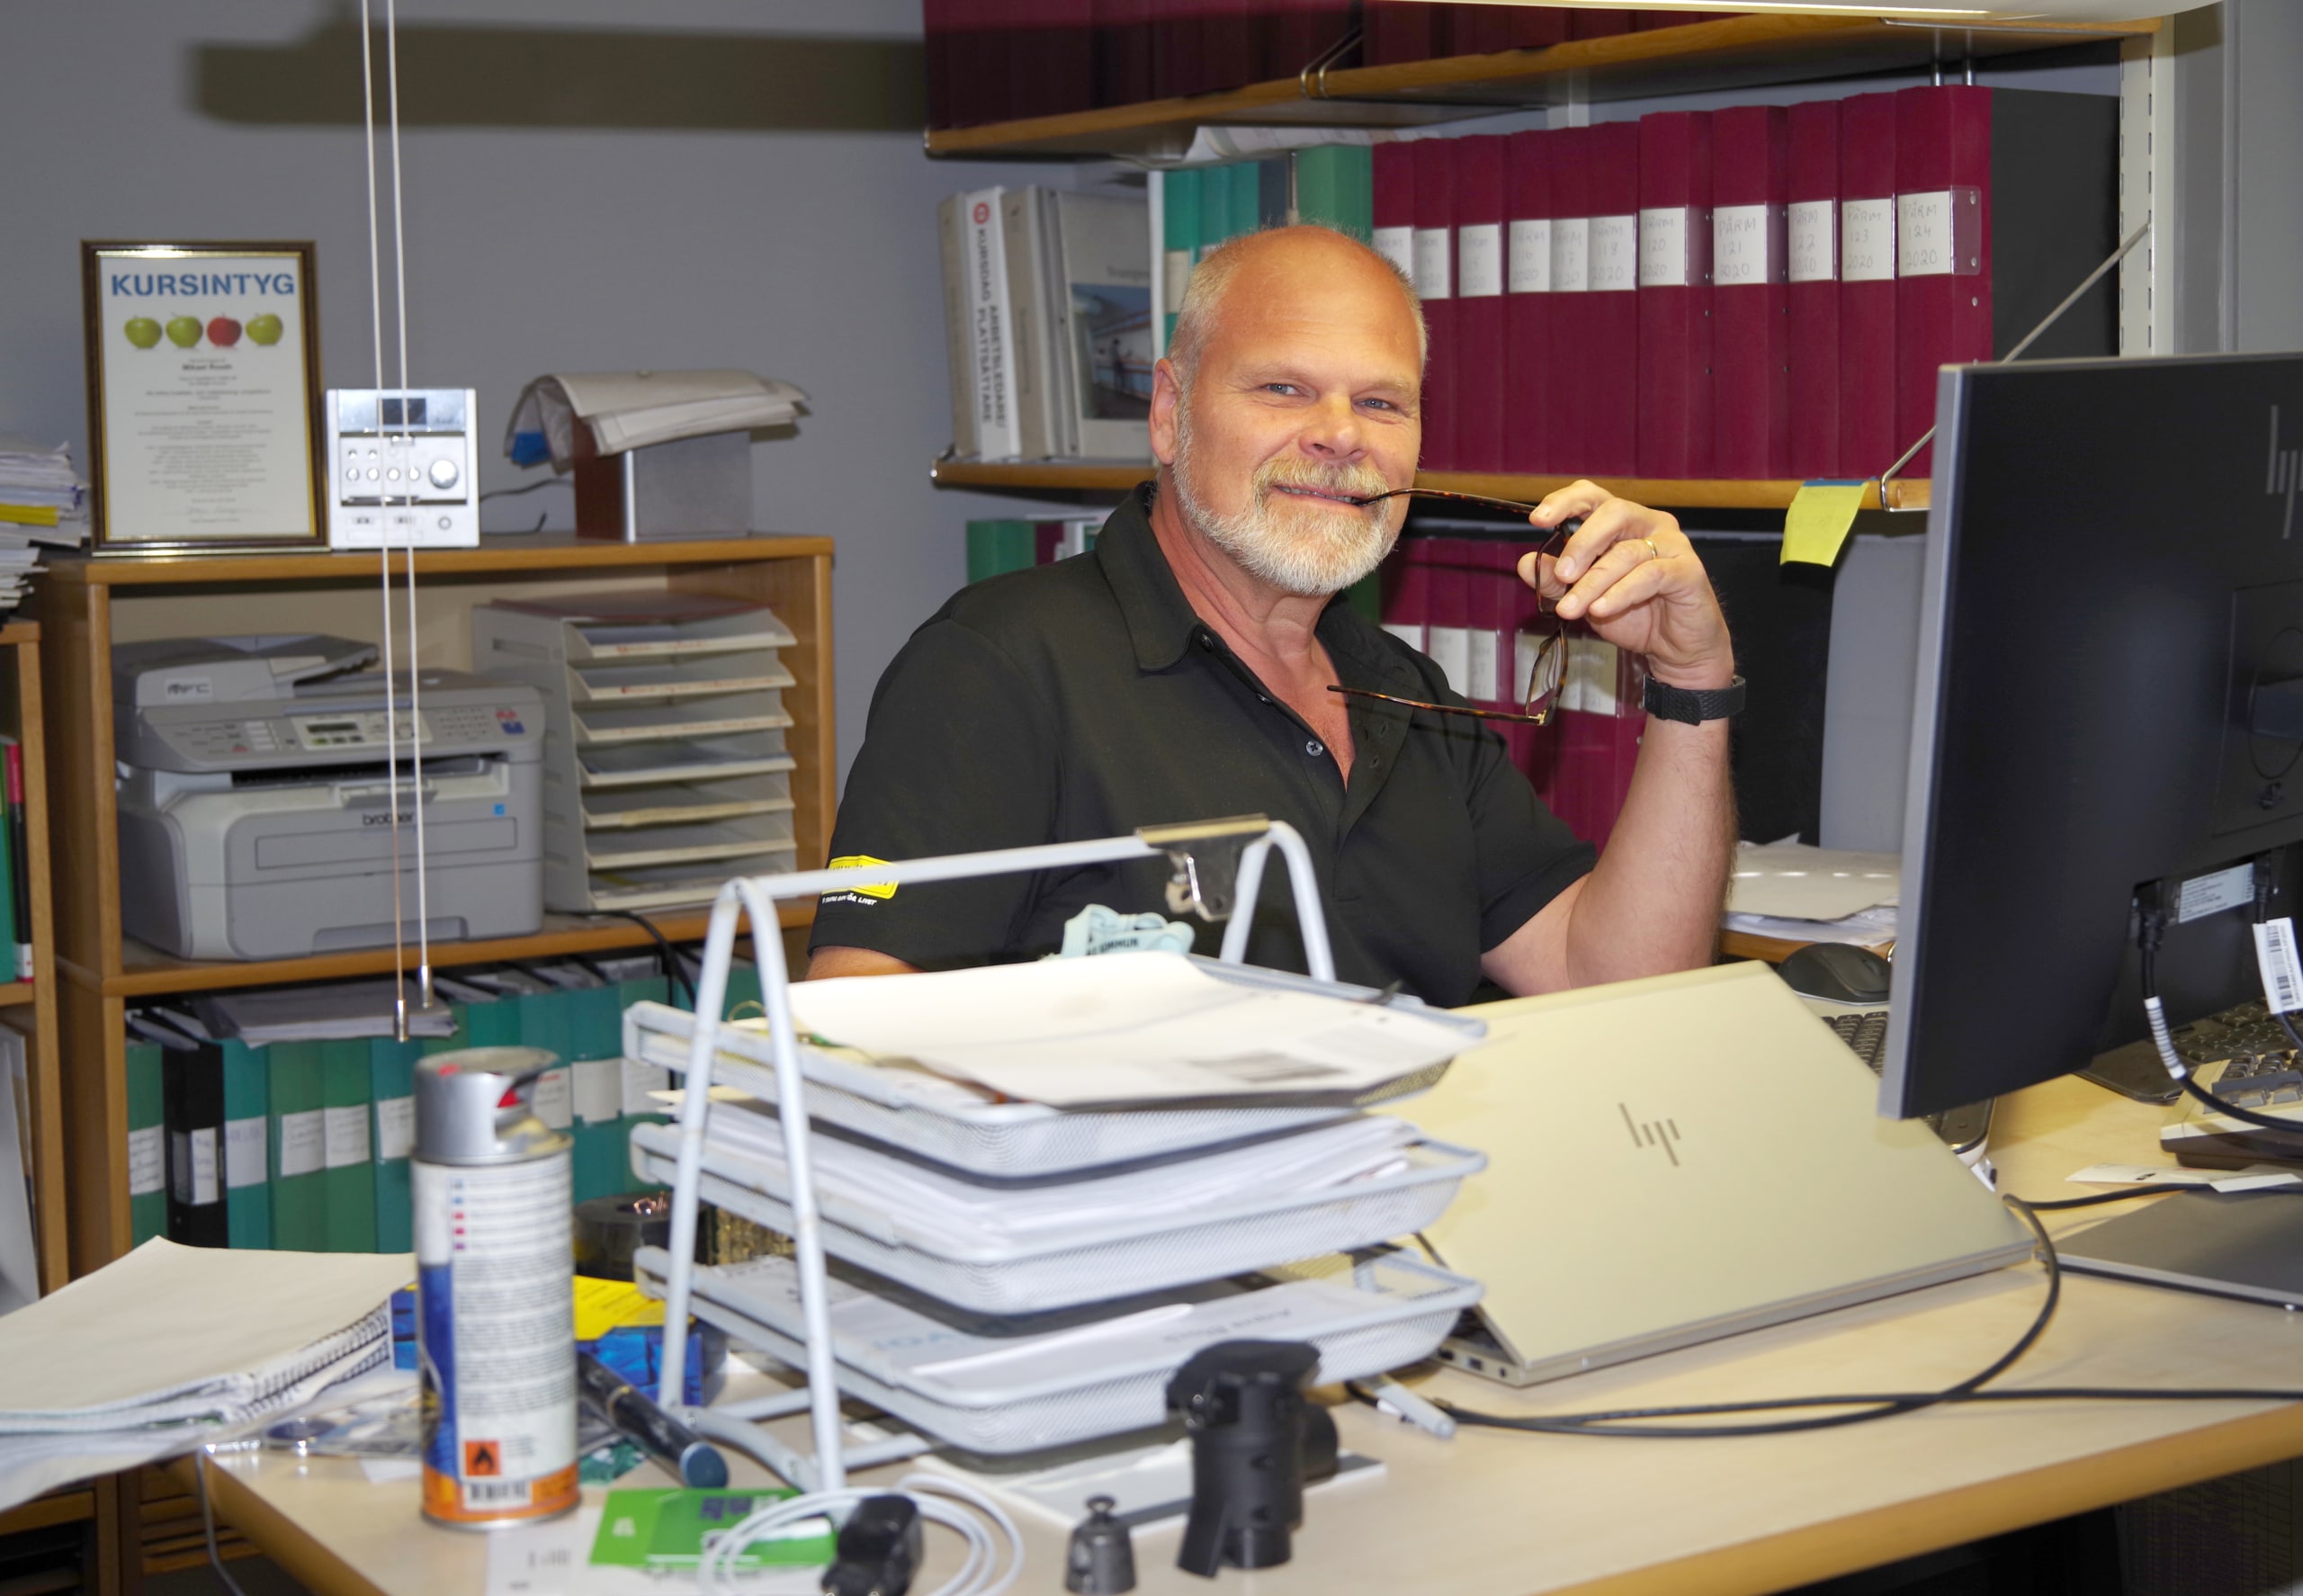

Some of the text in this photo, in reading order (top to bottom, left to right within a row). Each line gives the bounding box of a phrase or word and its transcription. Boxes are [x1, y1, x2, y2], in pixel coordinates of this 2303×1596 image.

[1847, 205, 1882, 222] PÄRM
[1904, 199, 1937, 220] PÄRM
[1644, 215, 1673, 231] PÄRM
[1719, 216, 1757, 238] PÄRM
[1850, 229, 1869, 244] 123
[1907, 226, 1931, 241] 124
[1647, 238, 1666, 253] 120
[1723, 239, 1743, 257] 121
[977, 228, 992, 302] KURSDAG
[1847, 255, 1873, 271] 2020
[1904, 250, 1938, 268] 2020
[1591, 266, 1624, 284] 2020
[1719, 262, 1750, 280] 2020
[112, 273, 295, 296] KURSINTYG
